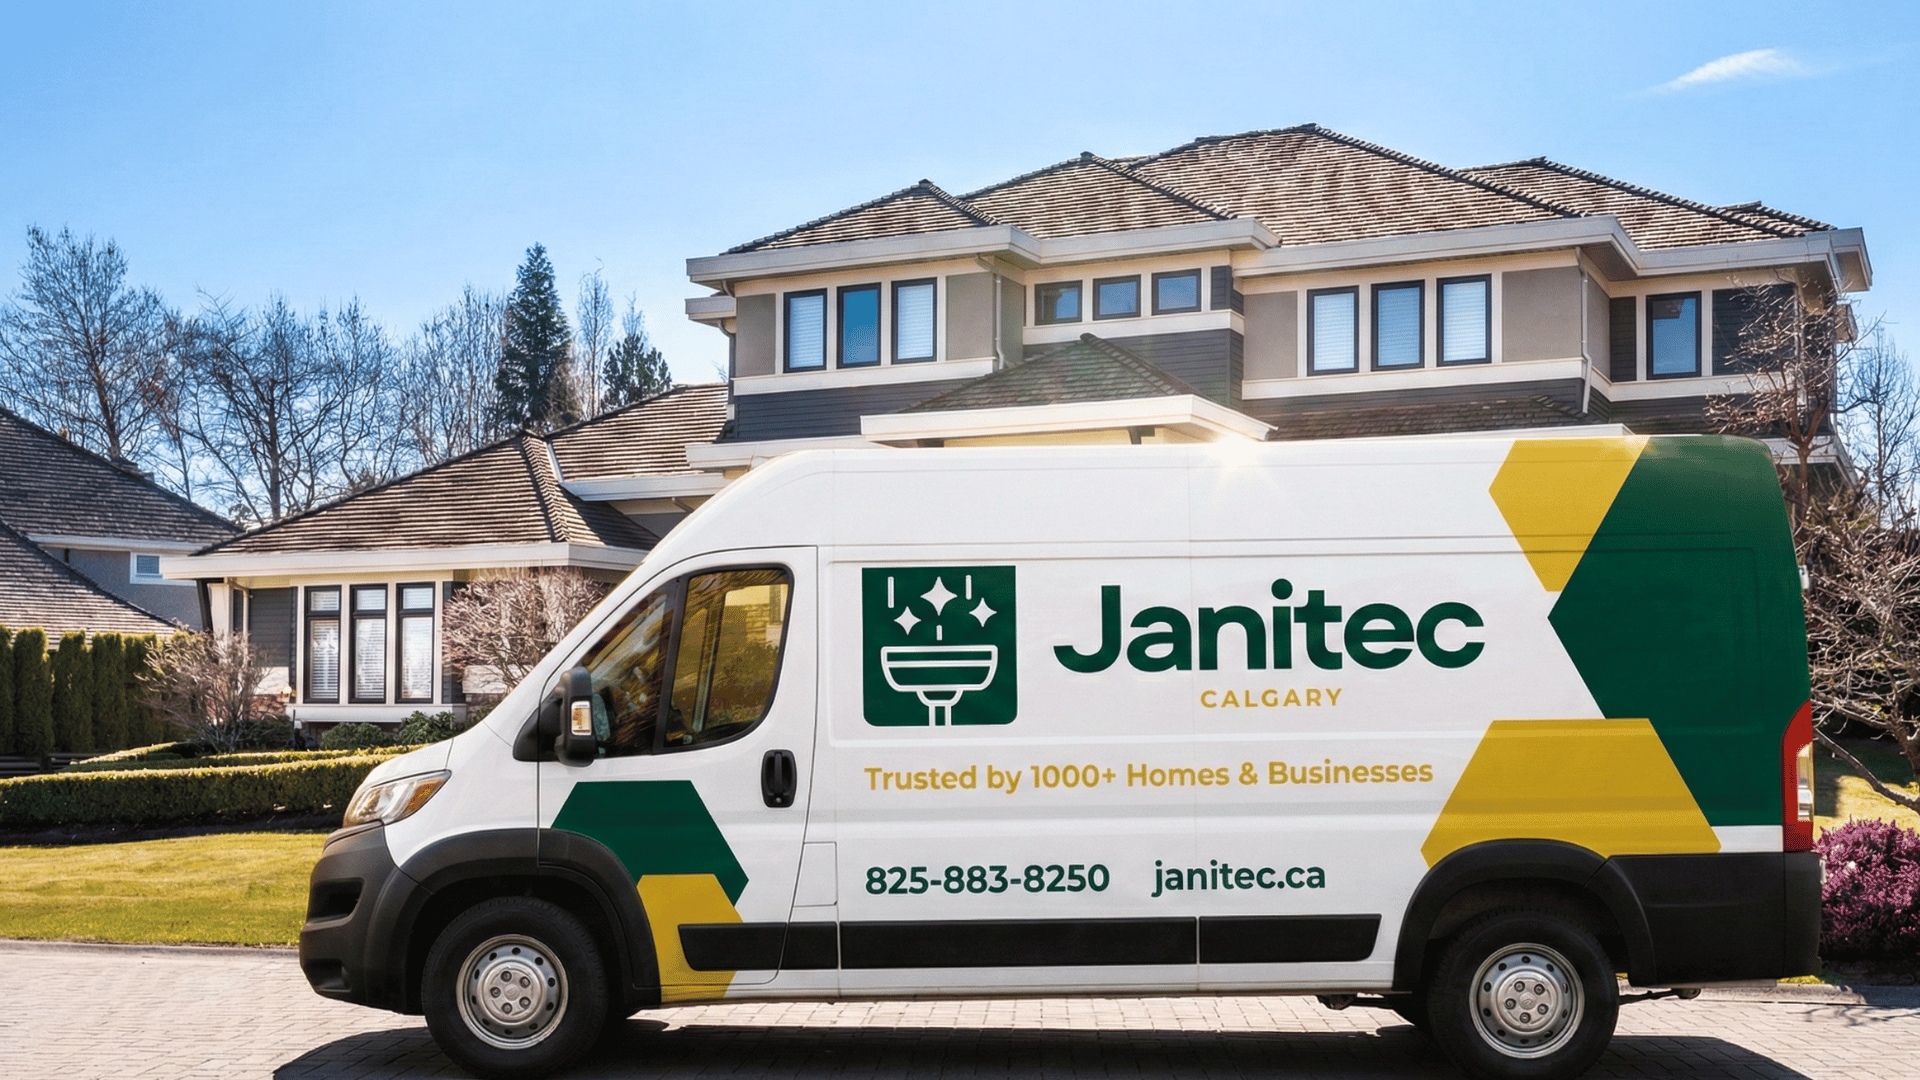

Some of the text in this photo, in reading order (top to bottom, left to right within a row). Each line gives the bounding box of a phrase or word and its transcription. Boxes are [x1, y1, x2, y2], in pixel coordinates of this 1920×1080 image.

[1054, 578, 1486, 673] Janitec
[1200, 687, 1342, 708] CALGARY
[864, 758, 1434, 795] Trusted by 1000+ Homes & Businesses
[865, 864, 1110, 894] 825-883-8250
[1151, 859, 1326, 897] janitec.ca
